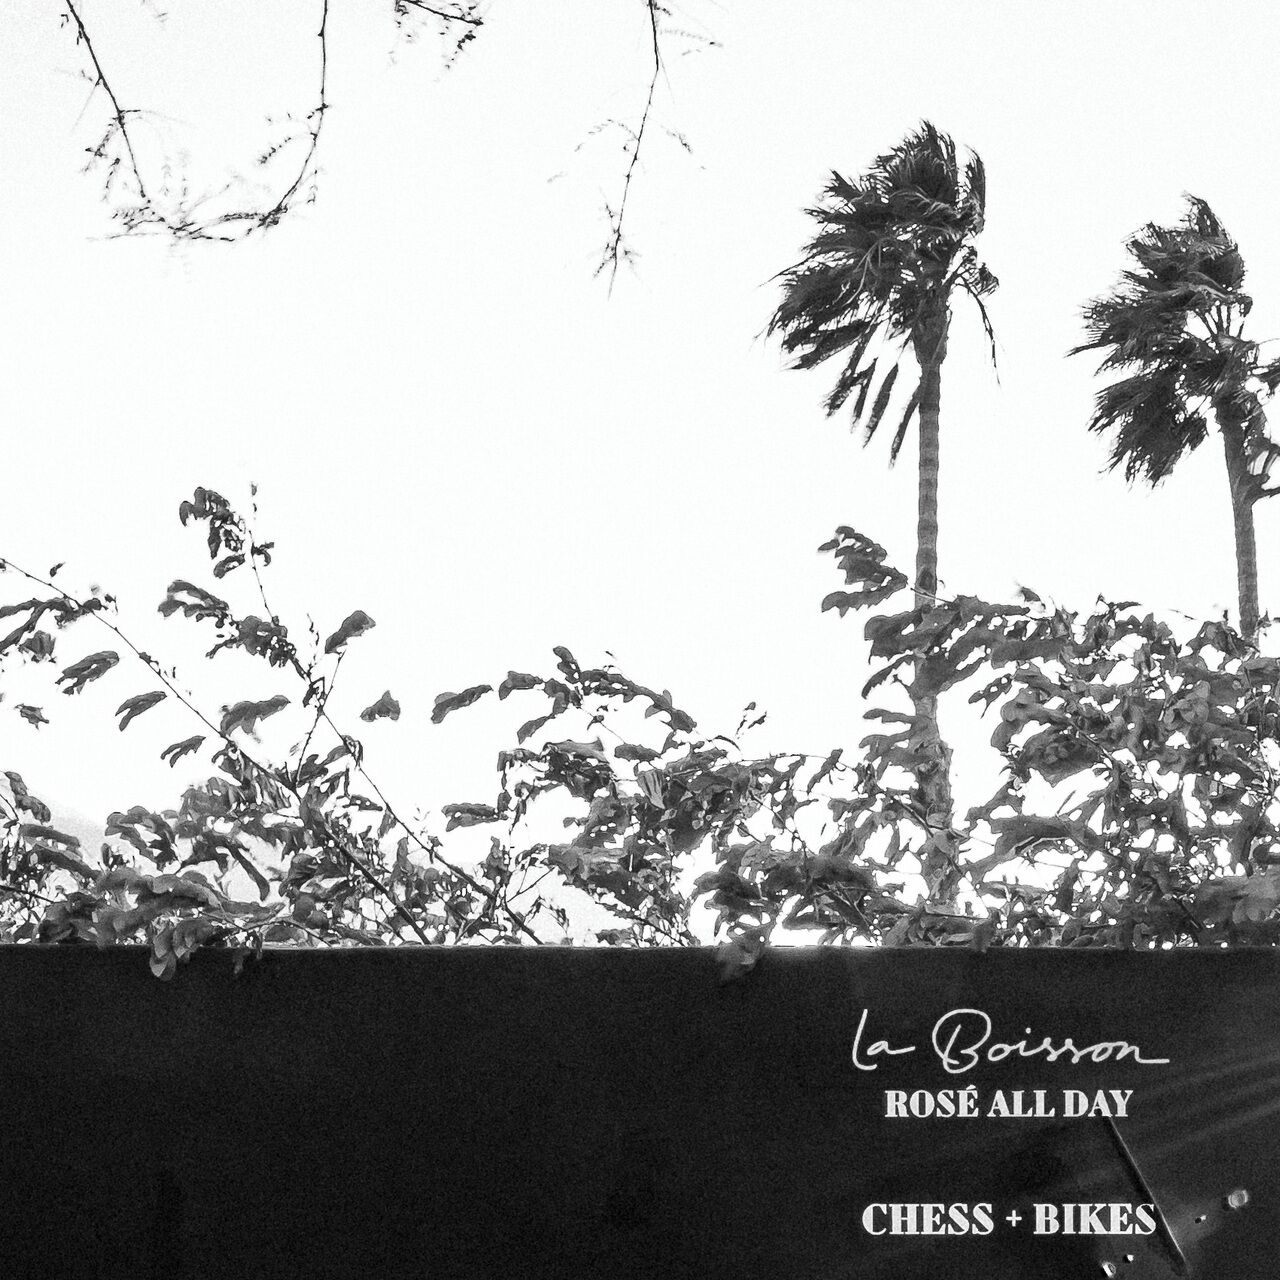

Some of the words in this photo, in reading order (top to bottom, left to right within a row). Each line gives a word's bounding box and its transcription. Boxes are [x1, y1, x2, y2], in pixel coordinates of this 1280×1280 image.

[931, 1008, 1170, 1074] Boisson
[885, 1084, 979, 1118] ROSÉ
[987, 1089, 1056, 1118] ALL
[1063, 1089, 1134, 1118] DAY
[862, 1202, 995, 1235] CHESS
[1005, 1209, 1023, 1228] +
[1033, 1202, 1157, 1235] BIKES
